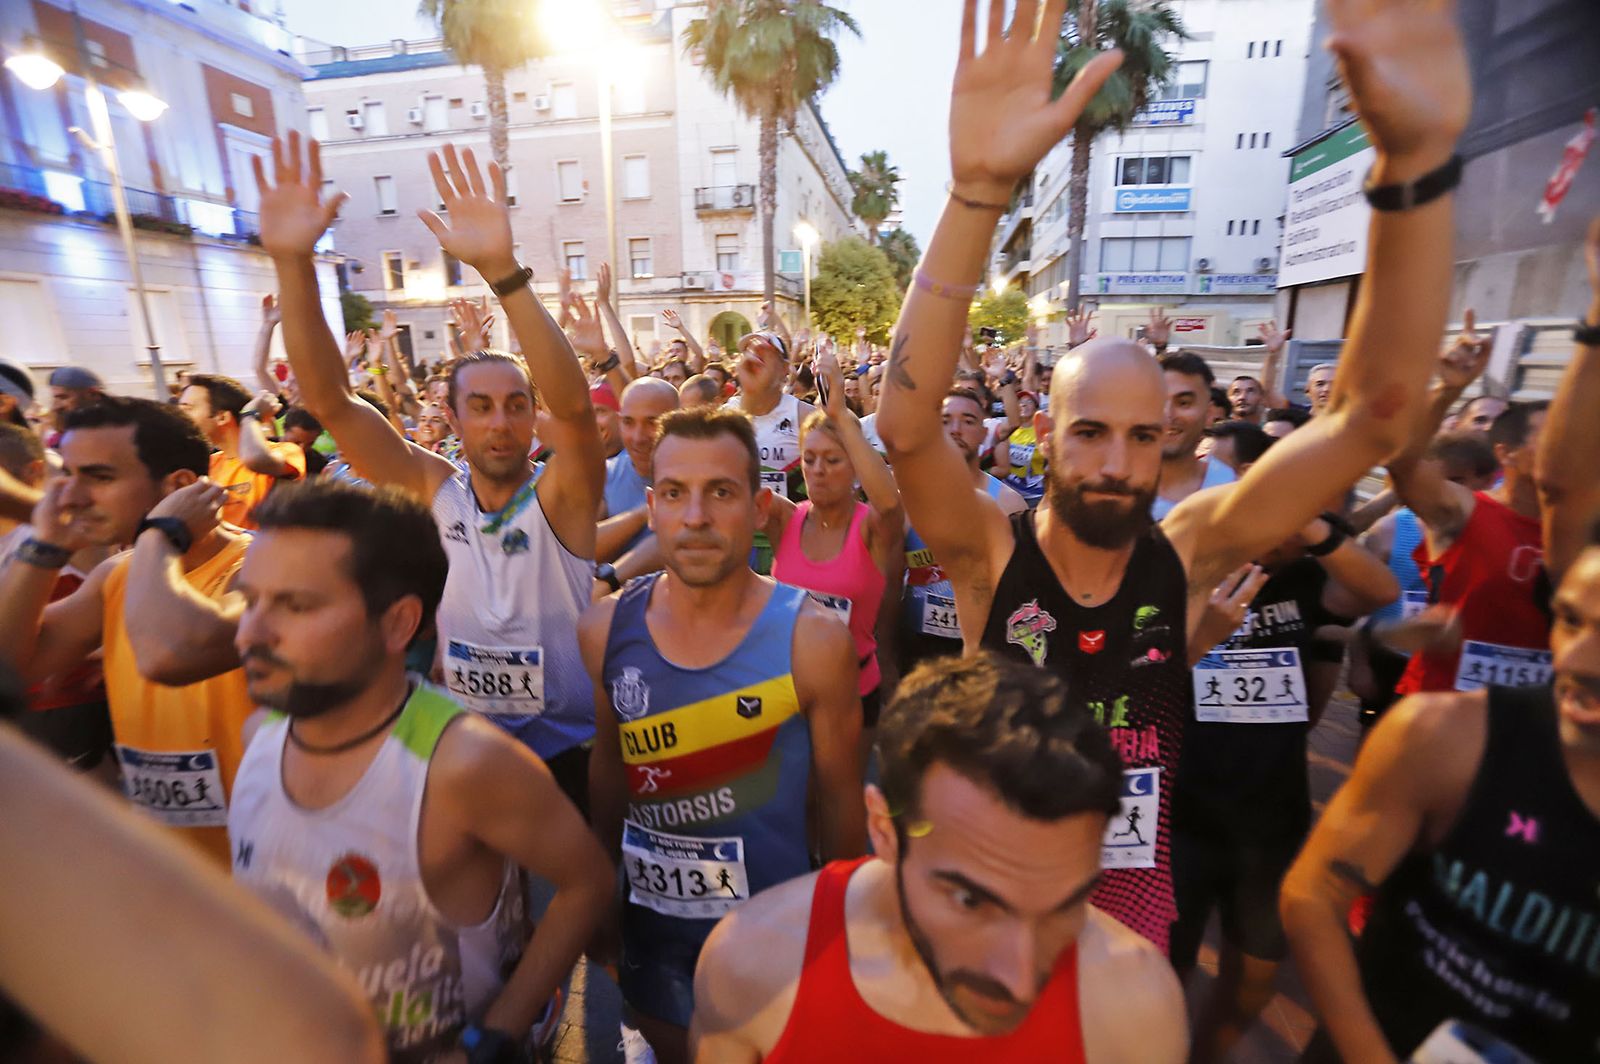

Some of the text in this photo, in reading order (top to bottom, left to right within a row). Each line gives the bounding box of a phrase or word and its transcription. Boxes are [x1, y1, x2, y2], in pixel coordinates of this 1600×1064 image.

[1117, 275, 1185, 284] PREVENTIVA
[1216, 275, 1277, 284] PREVENTIV
[468, 670, 513, 696] 588
[1234, 676, 1267, 703] 32
[624, 721, 678, 756] CLUB
[651, 864, 708, 897] 313
